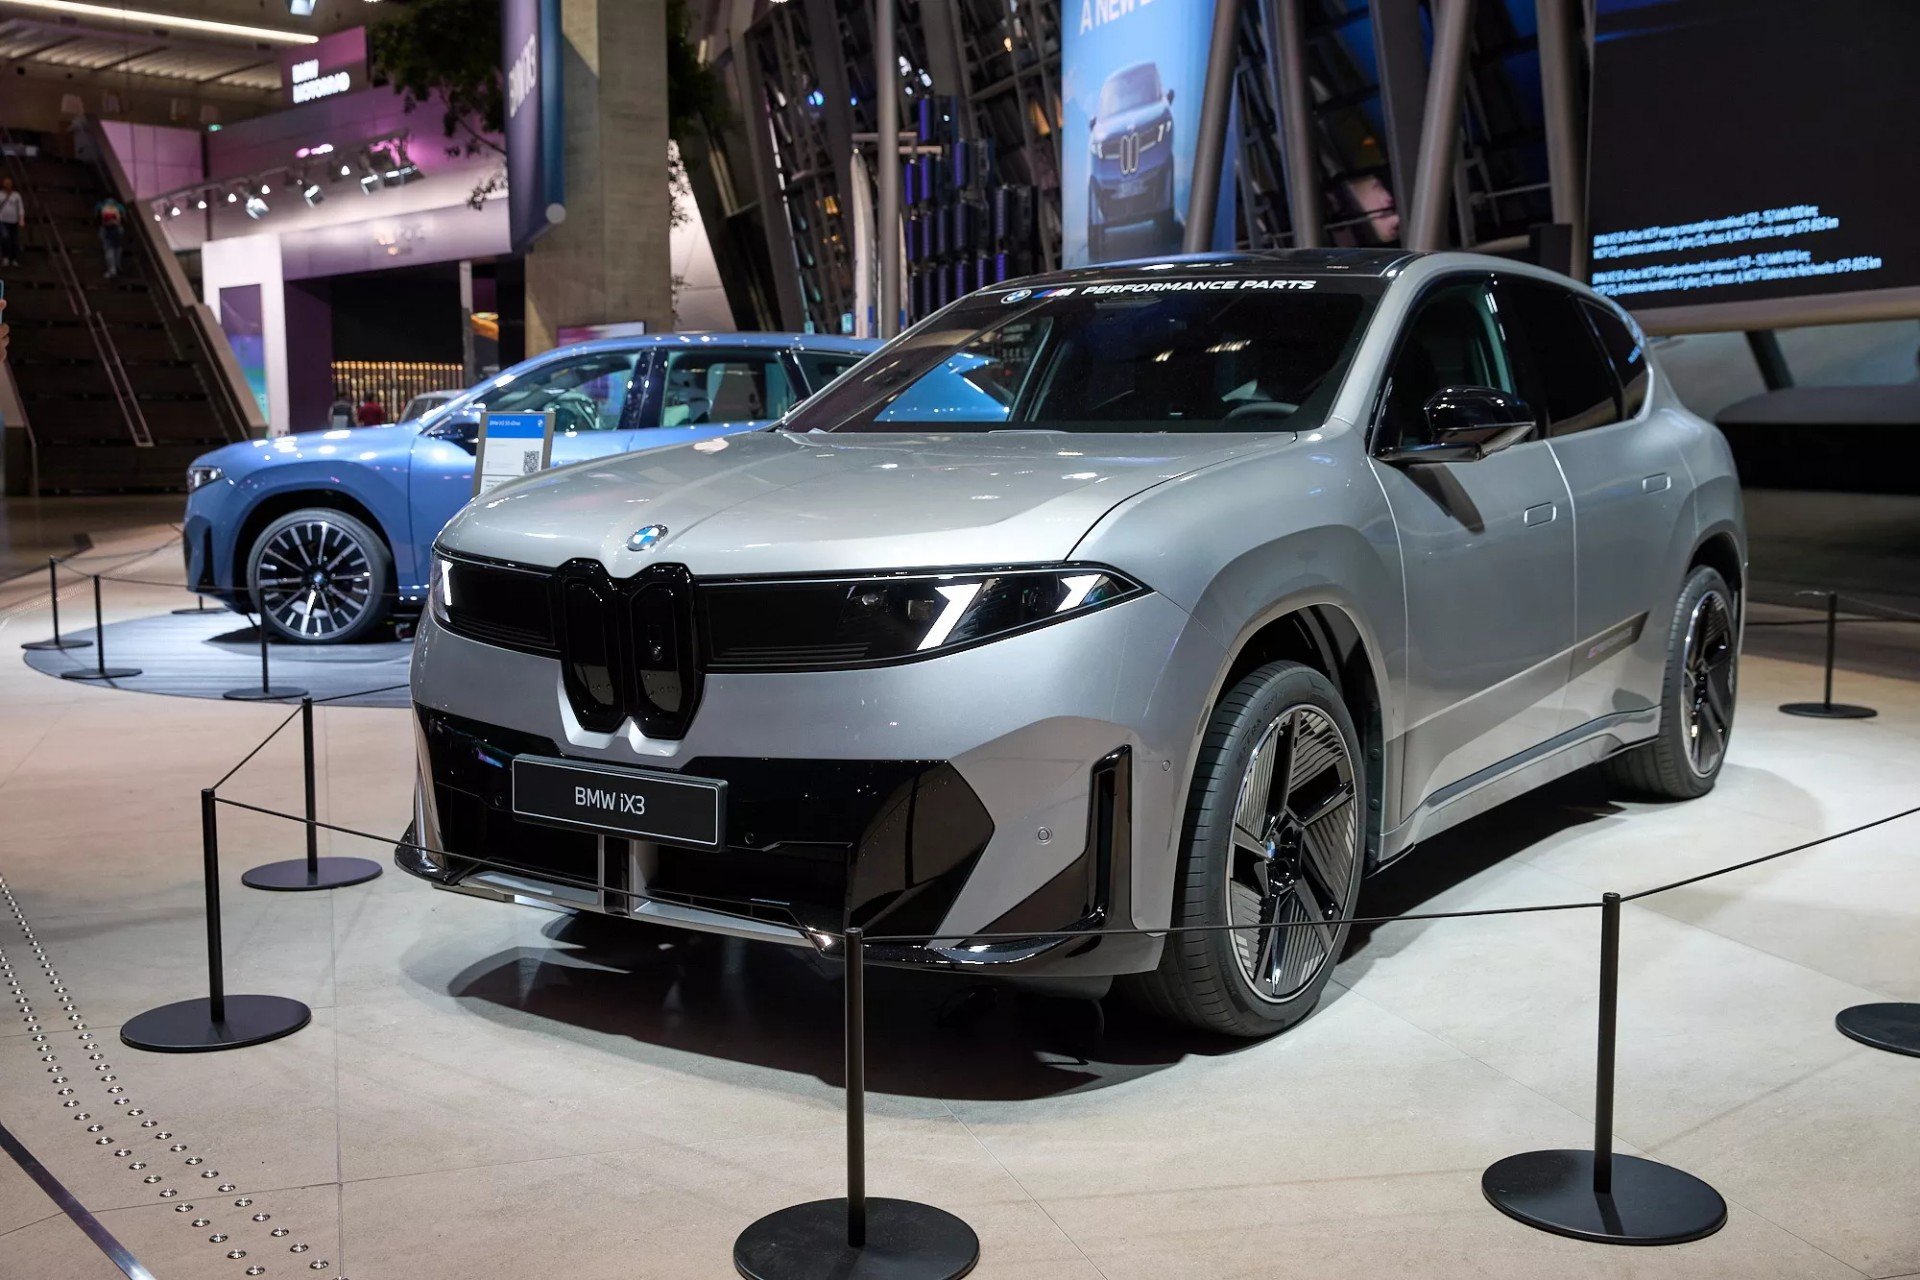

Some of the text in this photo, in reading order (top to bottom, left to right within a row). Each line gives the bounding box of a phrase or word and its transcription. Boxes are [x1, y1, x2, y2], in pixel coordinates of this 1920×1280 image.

[1080, 0, 1093, 36] A
[1081, 281, 1239, 296] PERFORMANCE
[1240, 280, 1317, 290] PARTS
[575, 786, 645, 815] BMW iX3
